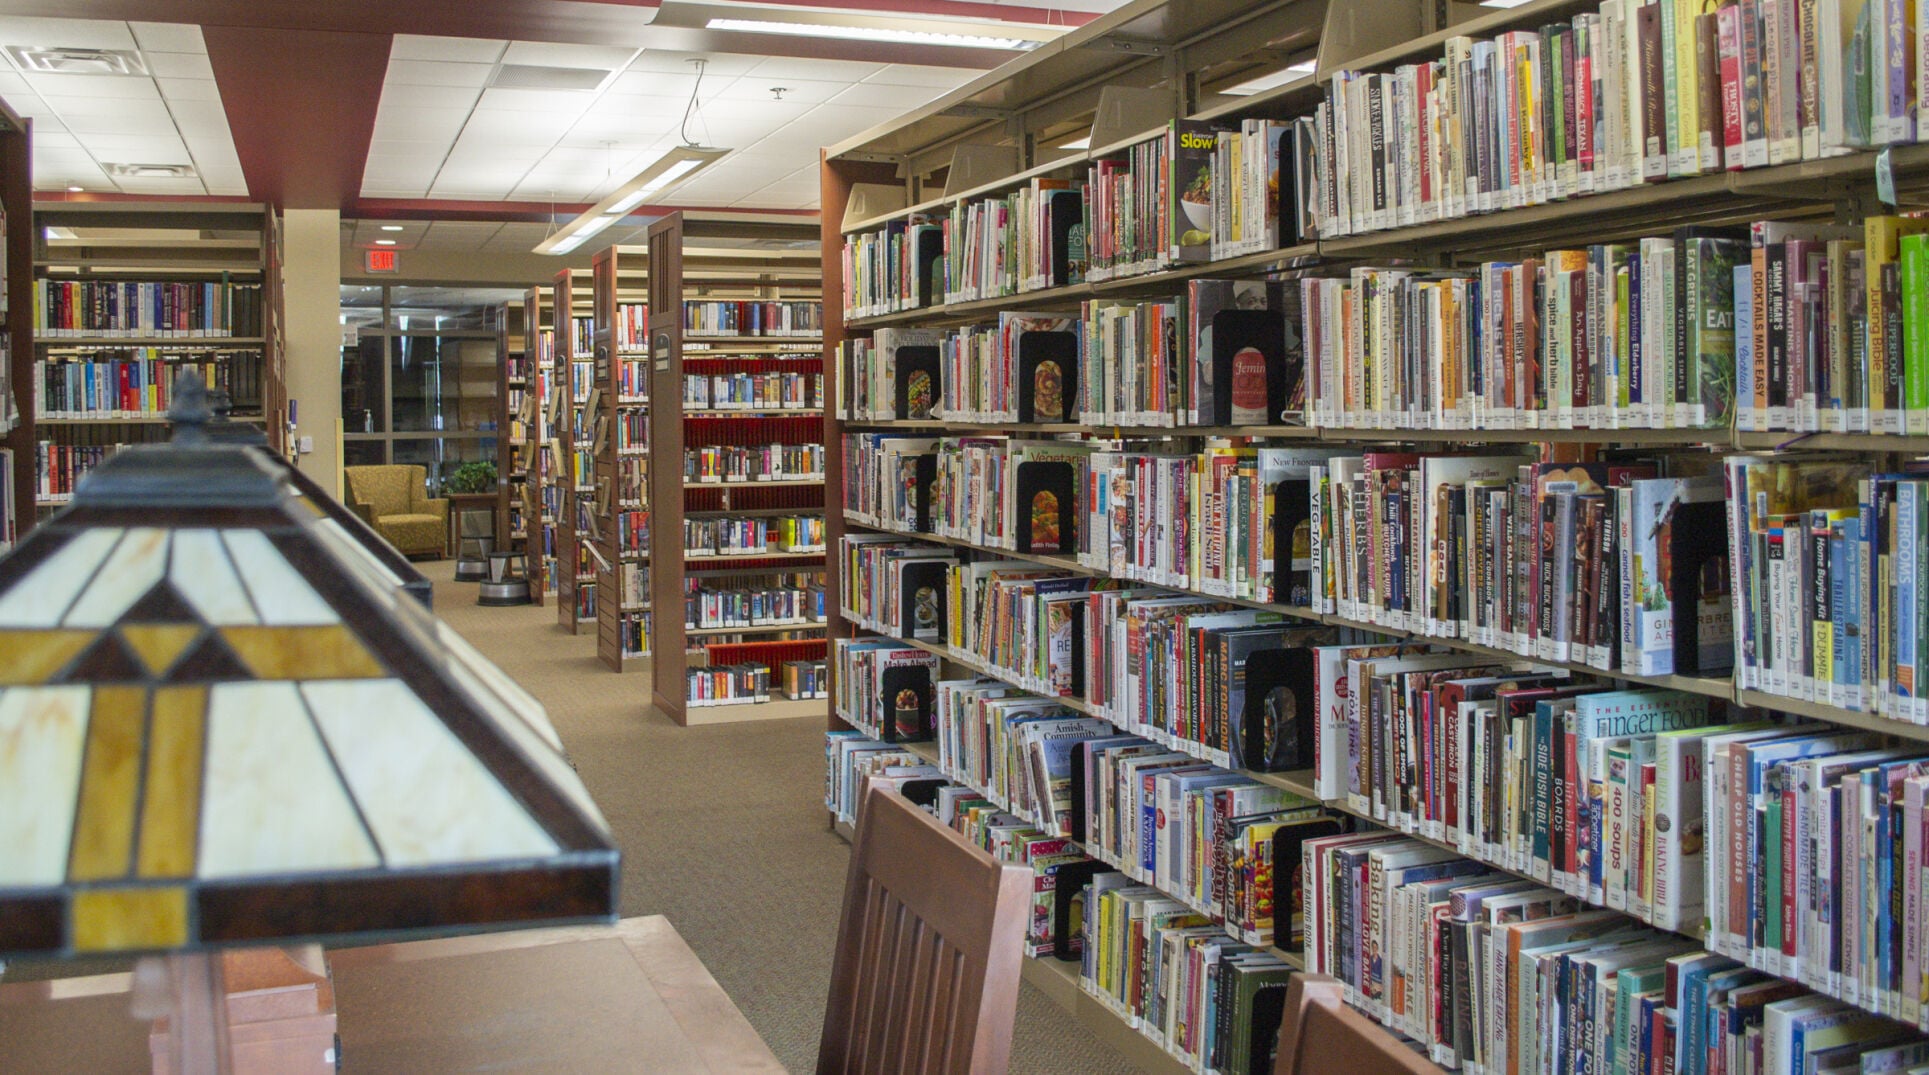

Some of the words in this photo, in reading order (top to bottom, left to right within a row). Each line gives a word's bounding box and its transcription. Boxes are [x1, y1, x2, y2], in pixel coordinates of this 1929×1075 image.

[1369, 88, 1381, 117] SMOKE
[1730, 81, 1739, 126] FROSTY
[1180, 133, 1213, 149] Slow
[1579, 119, 1587, 151] TEXAN
[1687, 248, 1695, 270] EAT
[1773, 260, 1782, 292] SAMMY
[1493, 289, 1503, 322] RICE
[1549, 297, 1558, 326] spice
[1687, 272, 1696, 321] GREENS
[1754, 271, 1763, 330] COCKTAILS
[1774, 296, 1783, 331] HAGAR'S
[1869, 287, 1882, 335] Juicing
[1576, 310, 1583, 327] An
[1630, 293, 1638, 341] Everything
[1706, 309, 1733, 328] EAT
[1786, 300, 1794, 352] MARTINIS
[1494, 329, 1503, 340] IS
[1515, 322, 1523, 364] HERSHEY'S
[1575, 329, 1583, 360] Apple
[1755, 334, 1763, 365] MADE
[1889, 312, 1898, 386] SUPERFOOD
[1495, 345, 1504, 378] LIFE
[1550, 341, 1559, 366] herb
[1630, 342, 1640, 390] Elderberry
[1738, 344, 1751, 394] Cocktails
[1873, 337, 1883, 371] Bible
[1550, 367, 1558, 389] bible
[1575, 373, 1583, 397] Day
[1755, 369, 1764, 397] EASY
[1205, 492, 1213, 535] Israeli
[1239, 479, 1248, 537] KENTUCKY
[1355, 491, 1367, 556] HERBS
[1389, 502, 1397, 520] Chili
[1312, 493, 1320, 574] VEG-TABLE
[1603, 519, 1612, 553] VENISON
[1899, 489, 1912, 585] BATHROOMS
[1729, 543, 1737, 579] NAPKIN
[1816, 537, 1825, 567] Home
[1543, 561, 1551, 583] BUCK,
[1815, 568, 1826, 603] Buying
[1623, 583, 1631, 600] fish
[1731, 580, 1739, 610] FOLDS
[1623, 607, 1632, 643] seafood
[1817, 604, 1826, 619] Kit
[1833, 579, 1843, 661] TRAILERSTEADING
[1220, 641, 1228, 681] MARC
[1817, 631, 1828, 681] DUMMIE
[1055, 722, 1084, 733] Amish
[1348, 690, 1356, 758] ROASTING
[1400, 737, 1406, 751] OF
[1537, 743, 1547, 770] SIDE
[1537, 773, 1547, 798] DISH
[1734, 755, 1742, 797] CHEAP
[1536, 800, 1547, 834] BIBLE
[1554, 778, 1563, 833] BOARDS
[1612, 786, 1621, 818] 400
[1734, 801, 1742, 827] OLD
[1589, 803, 1599, 852] appetizer
[1799, 806, 1809, 870] HANDMADE
[1819, 799, 1827, 846] Furniture
[1611, 821, 1622, 870] soups
[1656, 836, 1668, 875] BAKING
[1734, 832, 1743, 884] HOUSES
[1819, 848, 1827, 870] Flips
[1845, 834, 1853, 885] COMPLETE
[1799, 872, 1809, 896] TILE
[1907, 850, 1915, 891] SEWING
[1304, 888, 1312, 923] BAKING
[1370, 856, 1384, 935] Baking
[1907, 894, 1915, 923] MADE
[1305, 923, 1313, 950] BOOK
[1907, 925, 1915, 961] SIMPLE
[1584, 1019, 1594, 1050] ONE
[1629, 1024, 1638, 1050] ONE
[1629, 1052, 1637, 1075] POT
